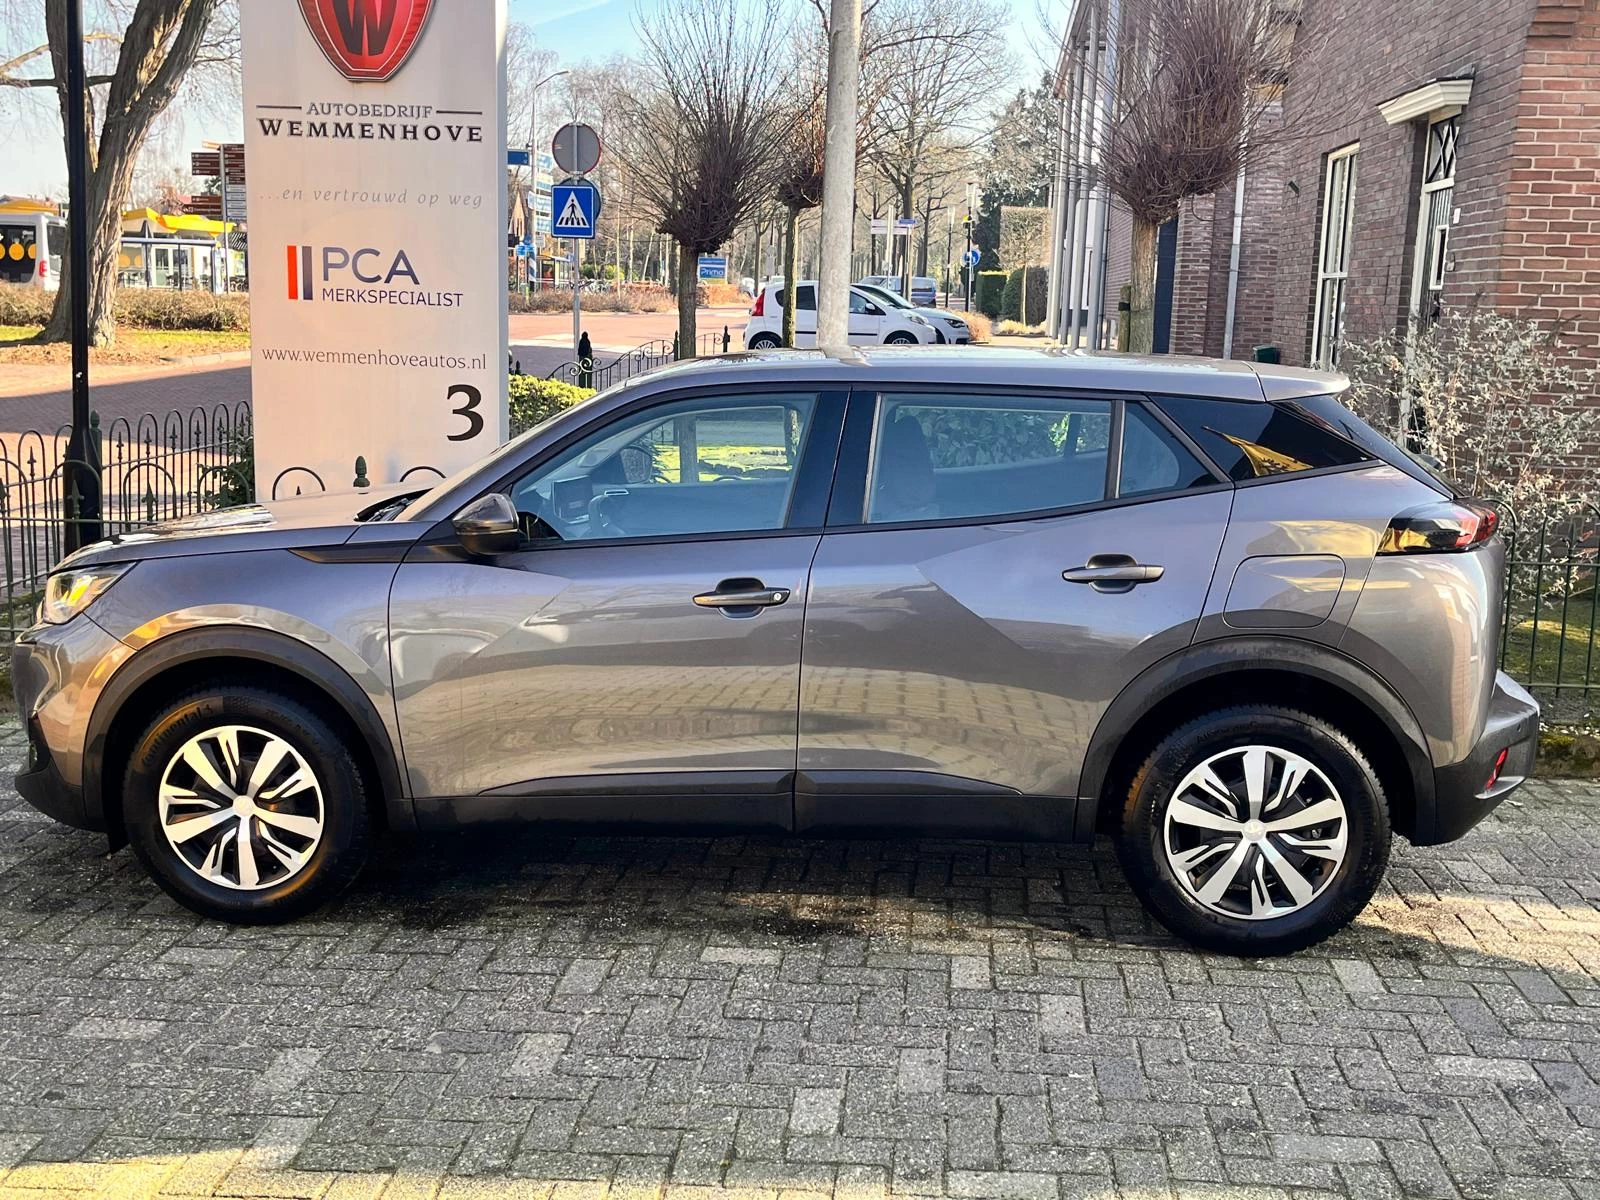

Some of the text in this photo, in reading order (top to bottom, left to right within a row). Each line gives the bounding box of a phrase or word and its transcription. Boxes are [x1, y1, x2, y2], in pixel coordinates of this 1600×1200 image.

[306, 103, 433, 119] AUTOBEDRIJF
[257, 118, 483, 142] WEMMENHOVE
[313, 189, 408, 205] vertrouwd
[417, 194, 440, 208] op
[449, 195, 484, 209] weg
[322, 247, 420, 285] PCA
[322, 288, 463, 307] MERKSPECIALIST
[261, 349, 487, 370] www.wemmenhoveautos.nl
[446, 384, 484, 441] 3
